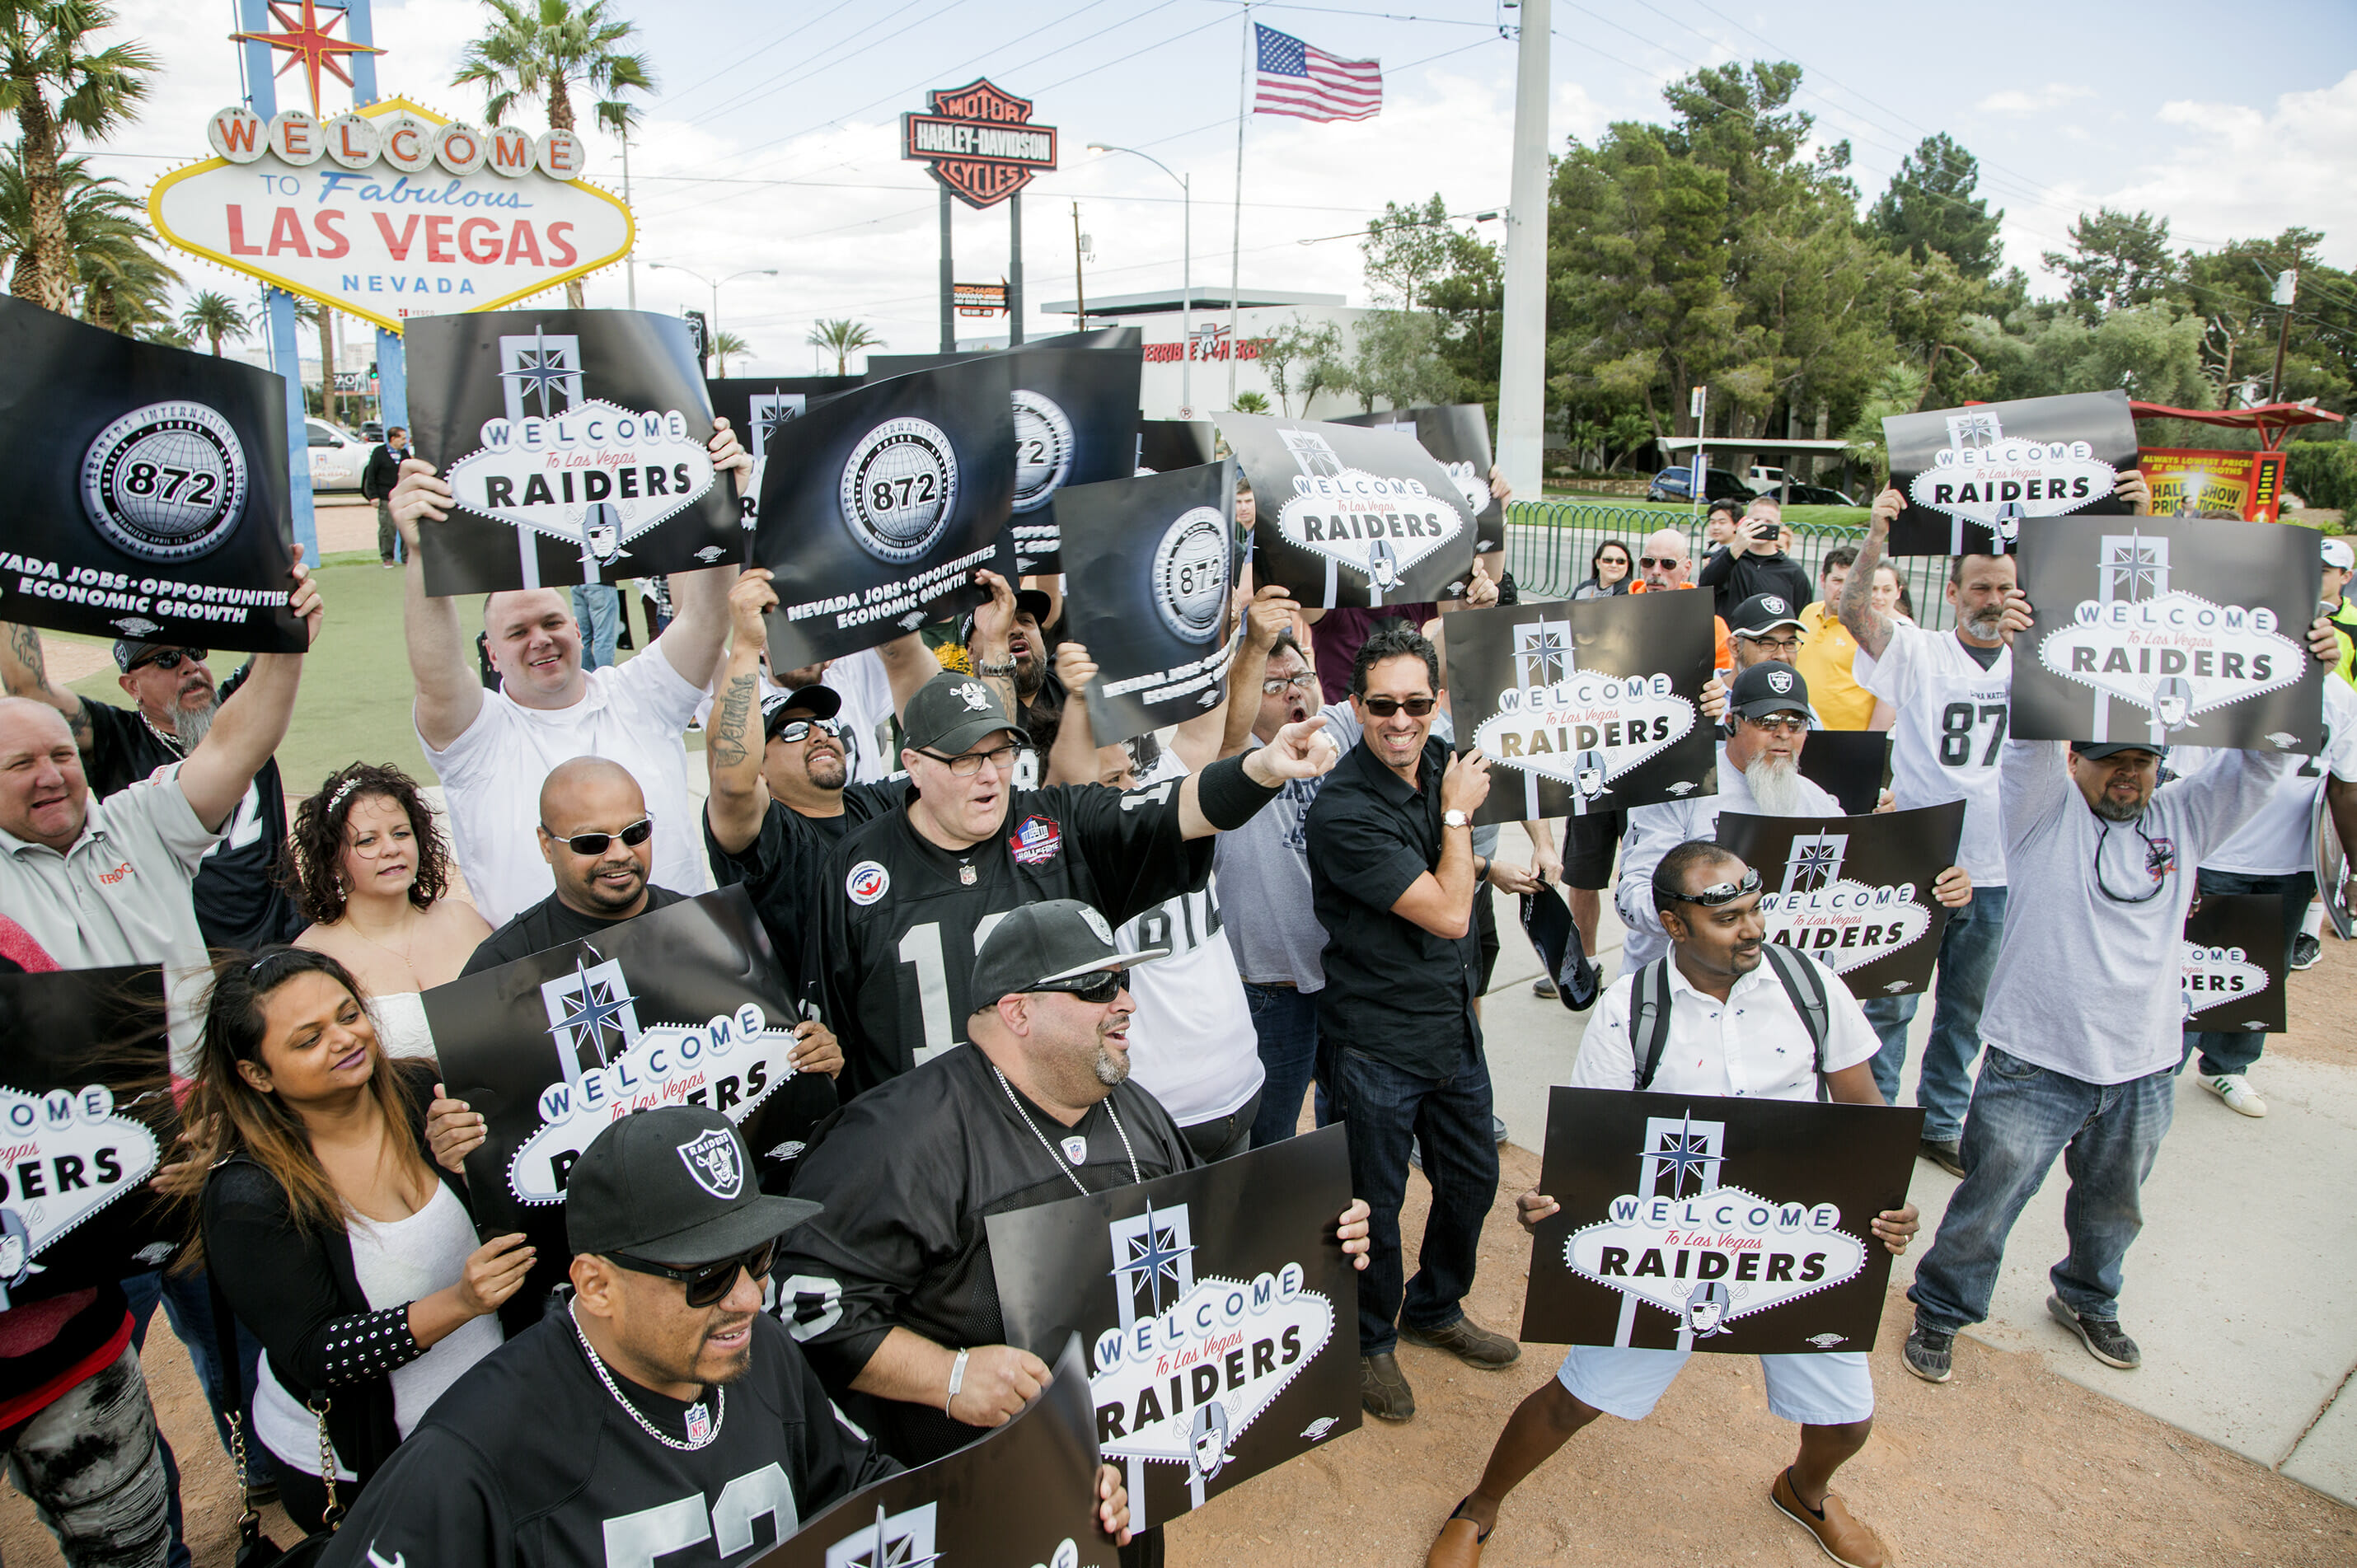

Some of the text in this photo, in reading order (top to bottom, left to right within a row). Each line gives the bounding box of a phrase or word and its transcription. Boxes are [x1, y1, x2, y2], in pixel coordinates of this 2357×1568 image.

[948, 88, 1021, 123] MOTOR
[217, 118, 574, 171] WELCOME
[916, 121, 1051, 161] HARLEY-DAVIDSON
[260, 171, 535, 208] TO Fabulous
[949, 160, 1020, 196] CYCLES
[226, 203, 578, 268] LAS VEGAS
[342, 274, 476, 295] NEVADA
[485, 416, 681, 447] WELCOME
[546, 450, 637, 473] To Las Vegas
[1938, 444, 2085, 466] WELCOME
[2142, 455, 2179, 464] ALWAYS
[2181, 457, 2219, 466] LOWEST
[2206, 466, 2242, 475] BOOTHS
[123, 459, 220, 509] 872
[485, 462, 692, 509] RAIDERS
[1293, 475, 1425, 496] WELCOME
[1975, 466, 2041, 481] To Las Vegas
[869, 470, 937, 514] 872
[1934, 476, 2090, 504] RAIDERS
[2201, 484, 2240, 503] SHOW
[1338, 499, 1396, 516] To Las Vegas
[2153, 500, 2181, 514] PRIC
[1303, 513, 1443, 541] RAIDERS
[66, 566, 129, 591] JOBS
[17, 577, 249, 624] ECONOMIC GROWTH
[786, 592, 860, 622] NEVADA
[862, 581, 902, 606] JOBS
[836, 571, 967, 630] ECONOMIC GROWTH
[2080, 606, 2270, 630] WELCOME
[2126, 630, 2214, 651] To Las Vegas
[2072, 646, 2273, 681] RAIDERS
[1502, 678, 1666, 709] WELCOME
[1546, 709, 1620, 728] To Las Vegas
[1501, 716, 1670, 758] RAIDERS
[1938, 702, 2008, 769] 87
[1760, 887, 1911, 911] WELCOME
[1792, 913, 1863, 929] To Las Vegas
[543, 1009, 757, 1117] WELCOME
[610, 1070, 706, 1123] To Las Vegas
[688, 1131, 729, 1157] RAIDERS
[1615, 1200, 1833, 1228] WELCOME
[1664, 1230, 1764, 1256] To Las Vegas
[1599, 1245, 1828, 1282] RAIDERS
[1099, 1267, 1298, 1365] WELCOME
[1156, 1329, 1244, 1377] To Las Vegas
[1095, 1325, 1303, 1444] RAIDERS
[691, 1420, 708, 1439] NFL
